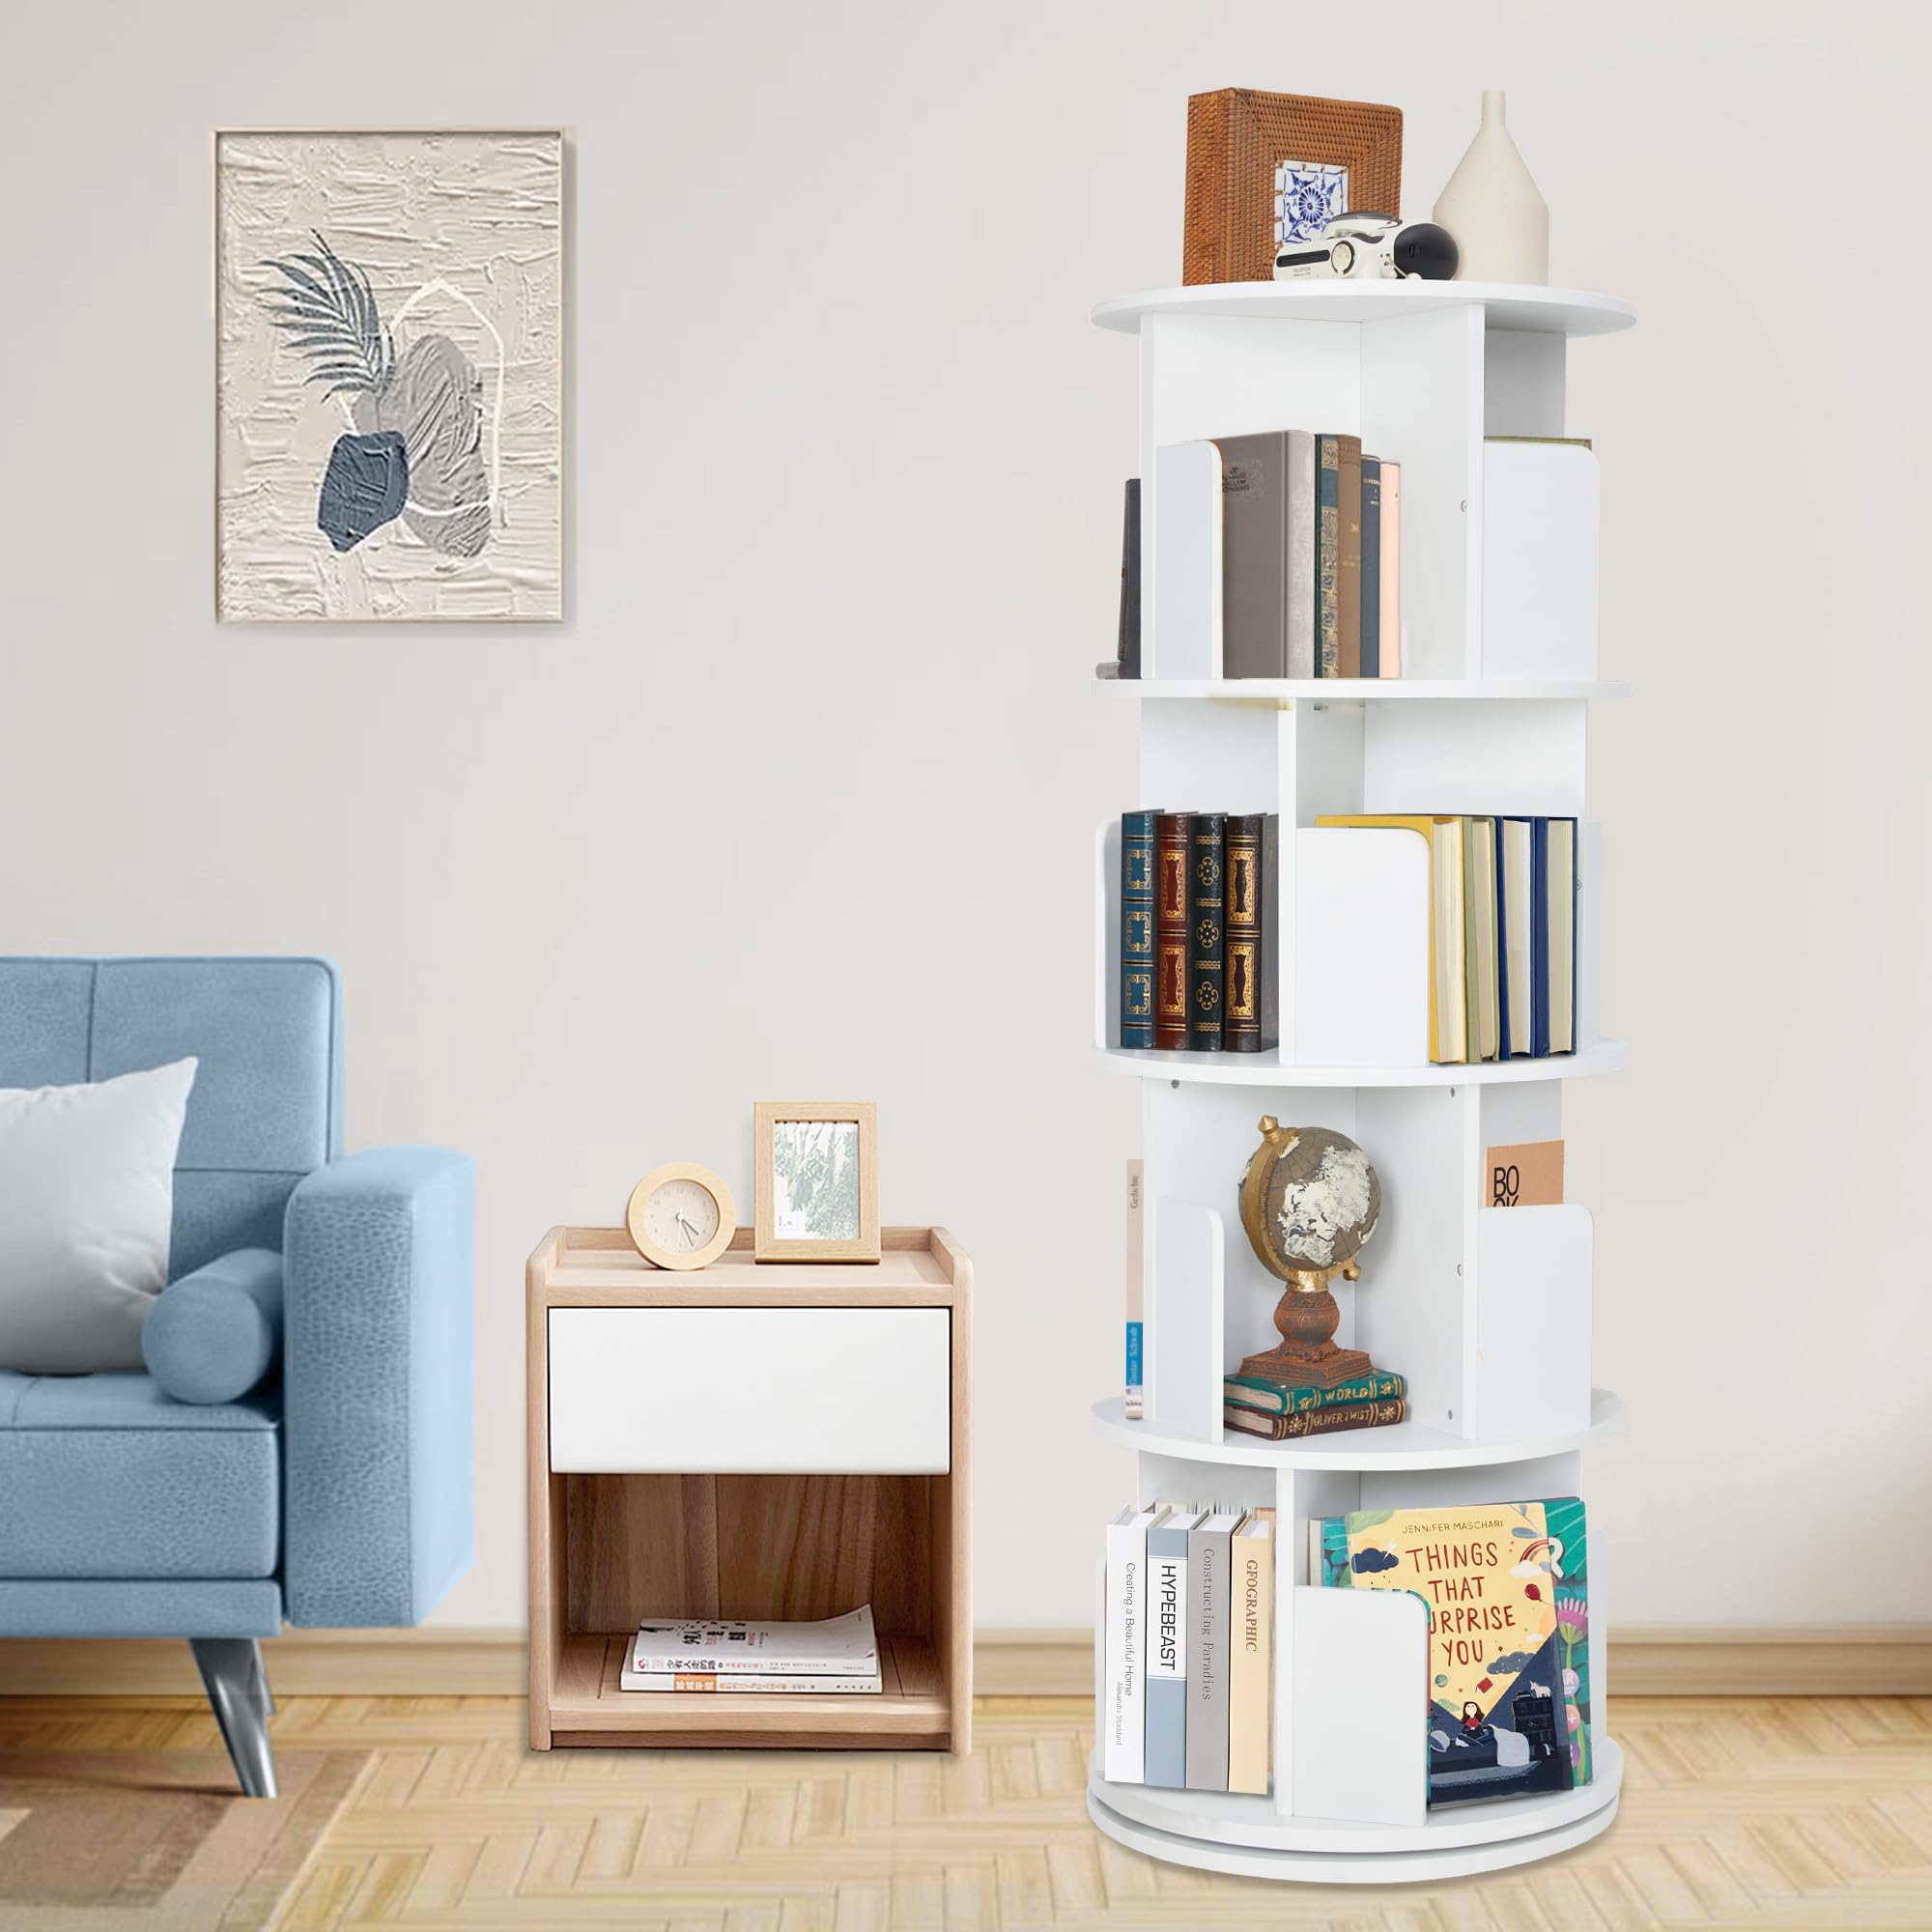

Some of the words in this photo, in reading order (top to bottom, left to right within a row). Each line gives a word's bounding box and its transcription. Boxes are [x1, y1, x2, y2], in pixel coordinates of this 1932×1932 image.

[1325, 1387, 1368, 1402] WORLD
[1314, 1412, 1343, 1427] OLIVER
[1345, 1410, 1370, 1422] TWIST
[1406, 1542, 1498, 1574] THINGS
[1123, 1562, 1136, 1605] Creating
[1202, 1548, 1214, 1635] Constructing
[1428, 1577, 1485, 1604] THAT
[1160, 1565, 1177, 1670] HYPEBEAST
[1430, 1605, 1516, 1634] URPRISE
[1124, 1618, 1135, 1662] Beautiful
[1441, 1639, 1484, 1667] YOU
[1124, 1665, 1134, 1696] Home
[1203, 1642, 1214, 1700] Paradies
